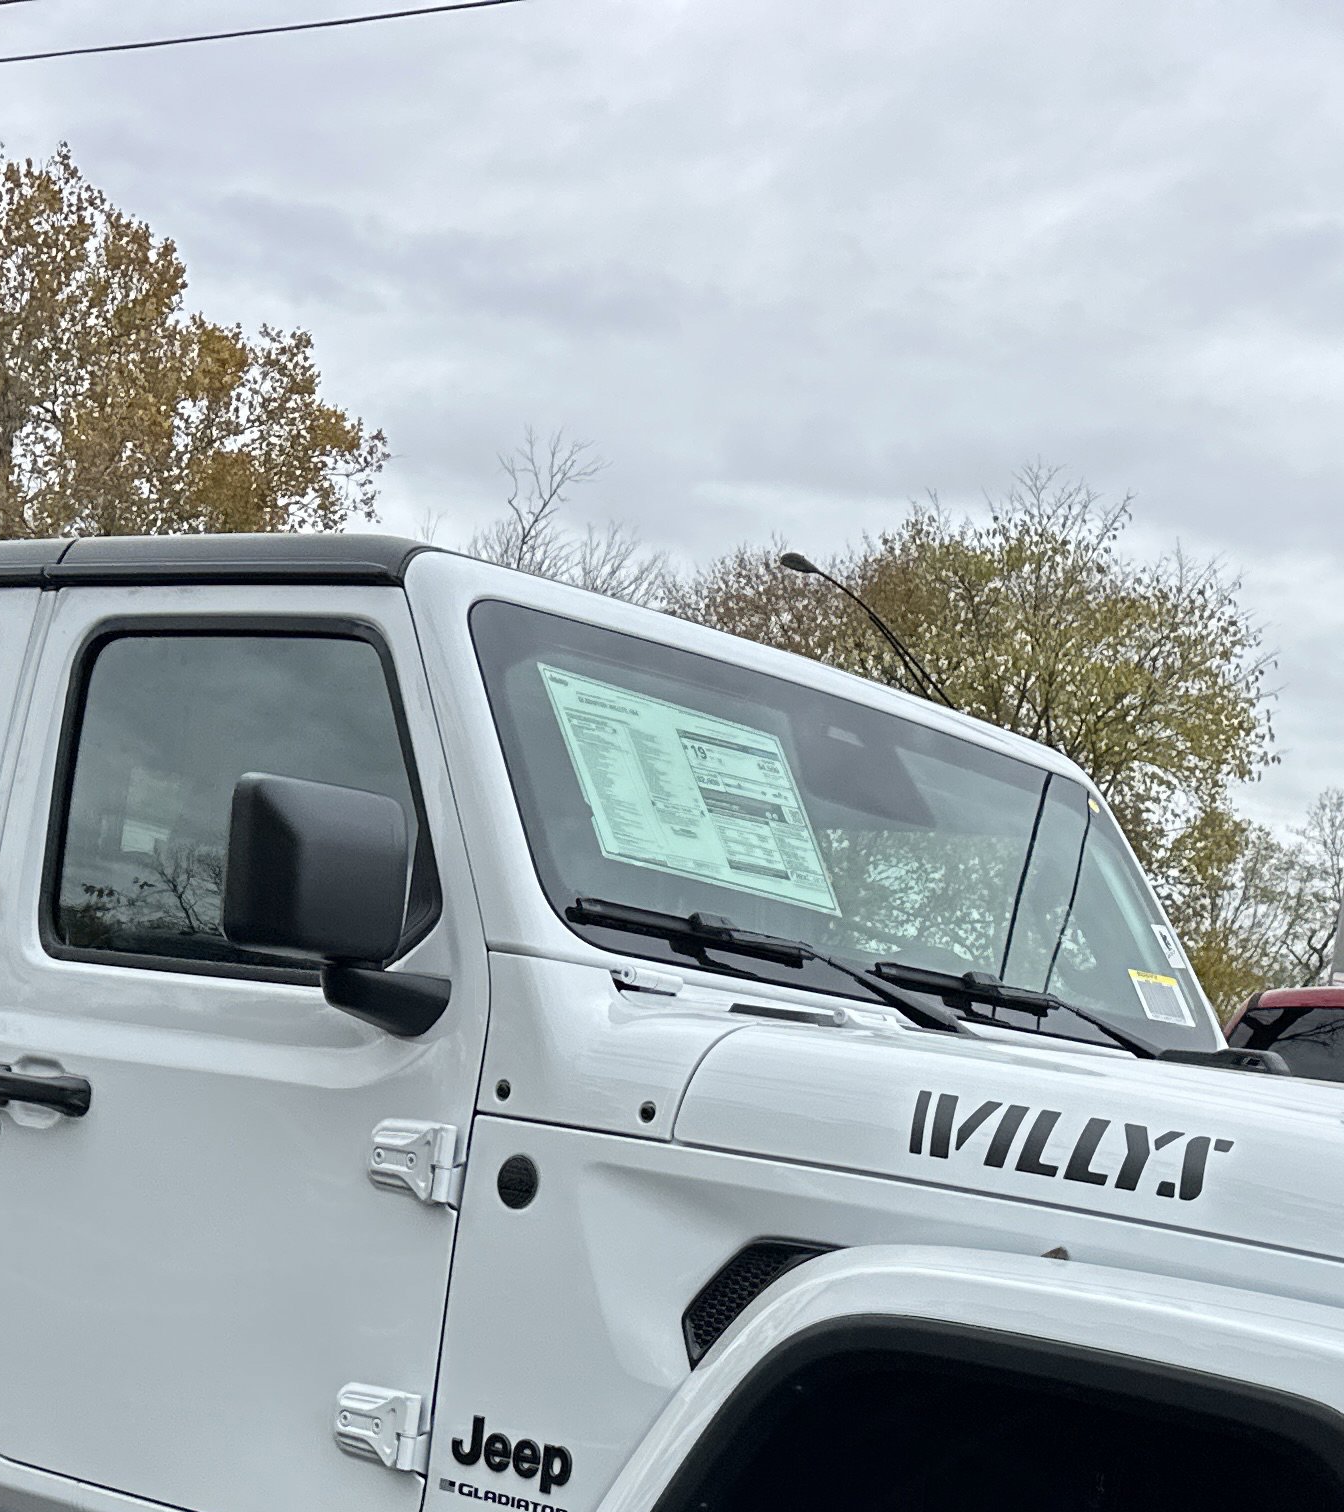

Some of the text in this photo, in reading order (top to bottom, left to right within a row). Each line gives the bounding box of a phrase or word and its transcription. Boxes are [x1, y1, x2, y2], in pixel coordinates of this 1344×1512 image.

[690, 744, 707, 760] 19
[909, 1090, 1235, 1201] WILLYS
[451, 1414, 573, 1495] Jeep
